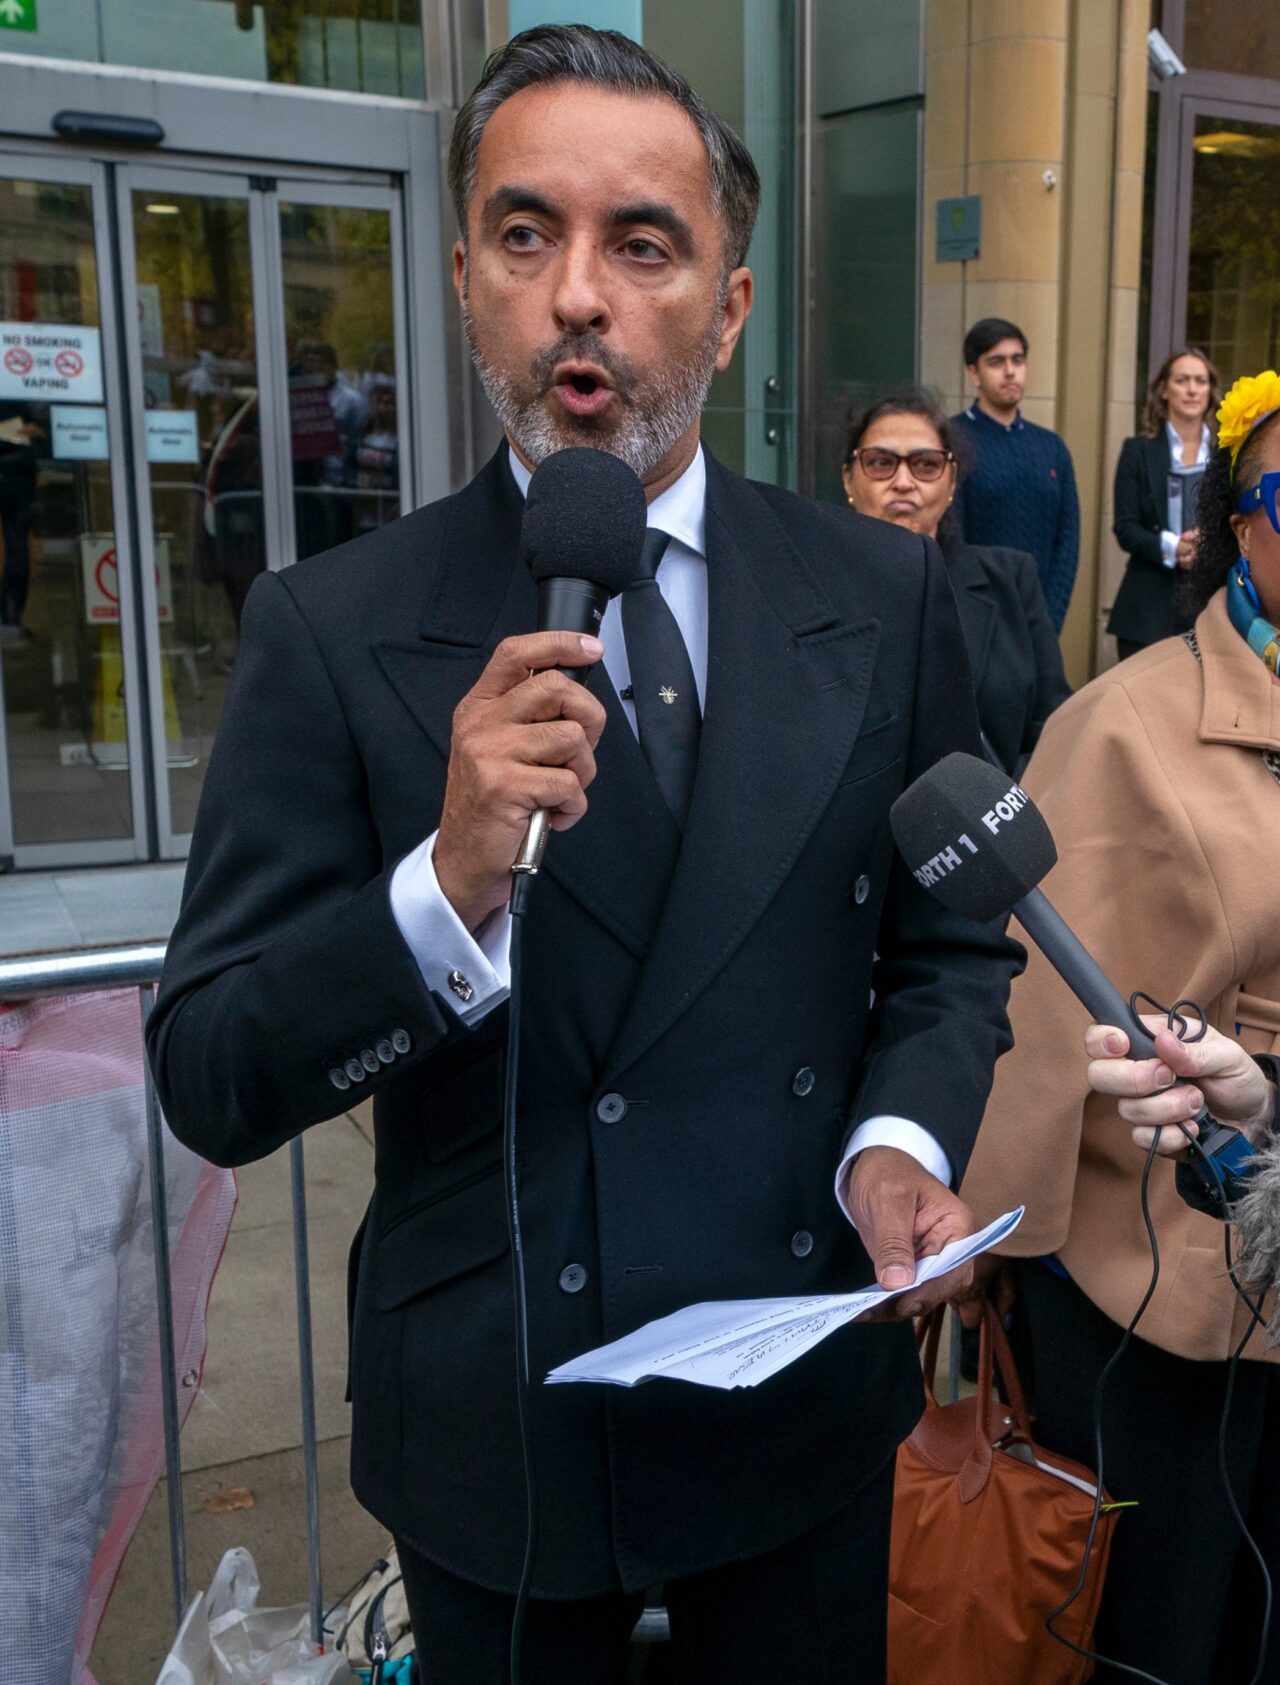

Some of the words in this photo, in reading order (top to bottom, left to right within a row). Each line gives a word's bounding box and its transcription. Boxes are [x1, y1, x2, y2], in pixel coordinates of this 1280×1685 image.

[2, 334, 20, 346] NO
[24, 334, 82, 348] SMOKING
[22, 377, 70, 390] VAPING
[957, 833, 979, 854] 1
